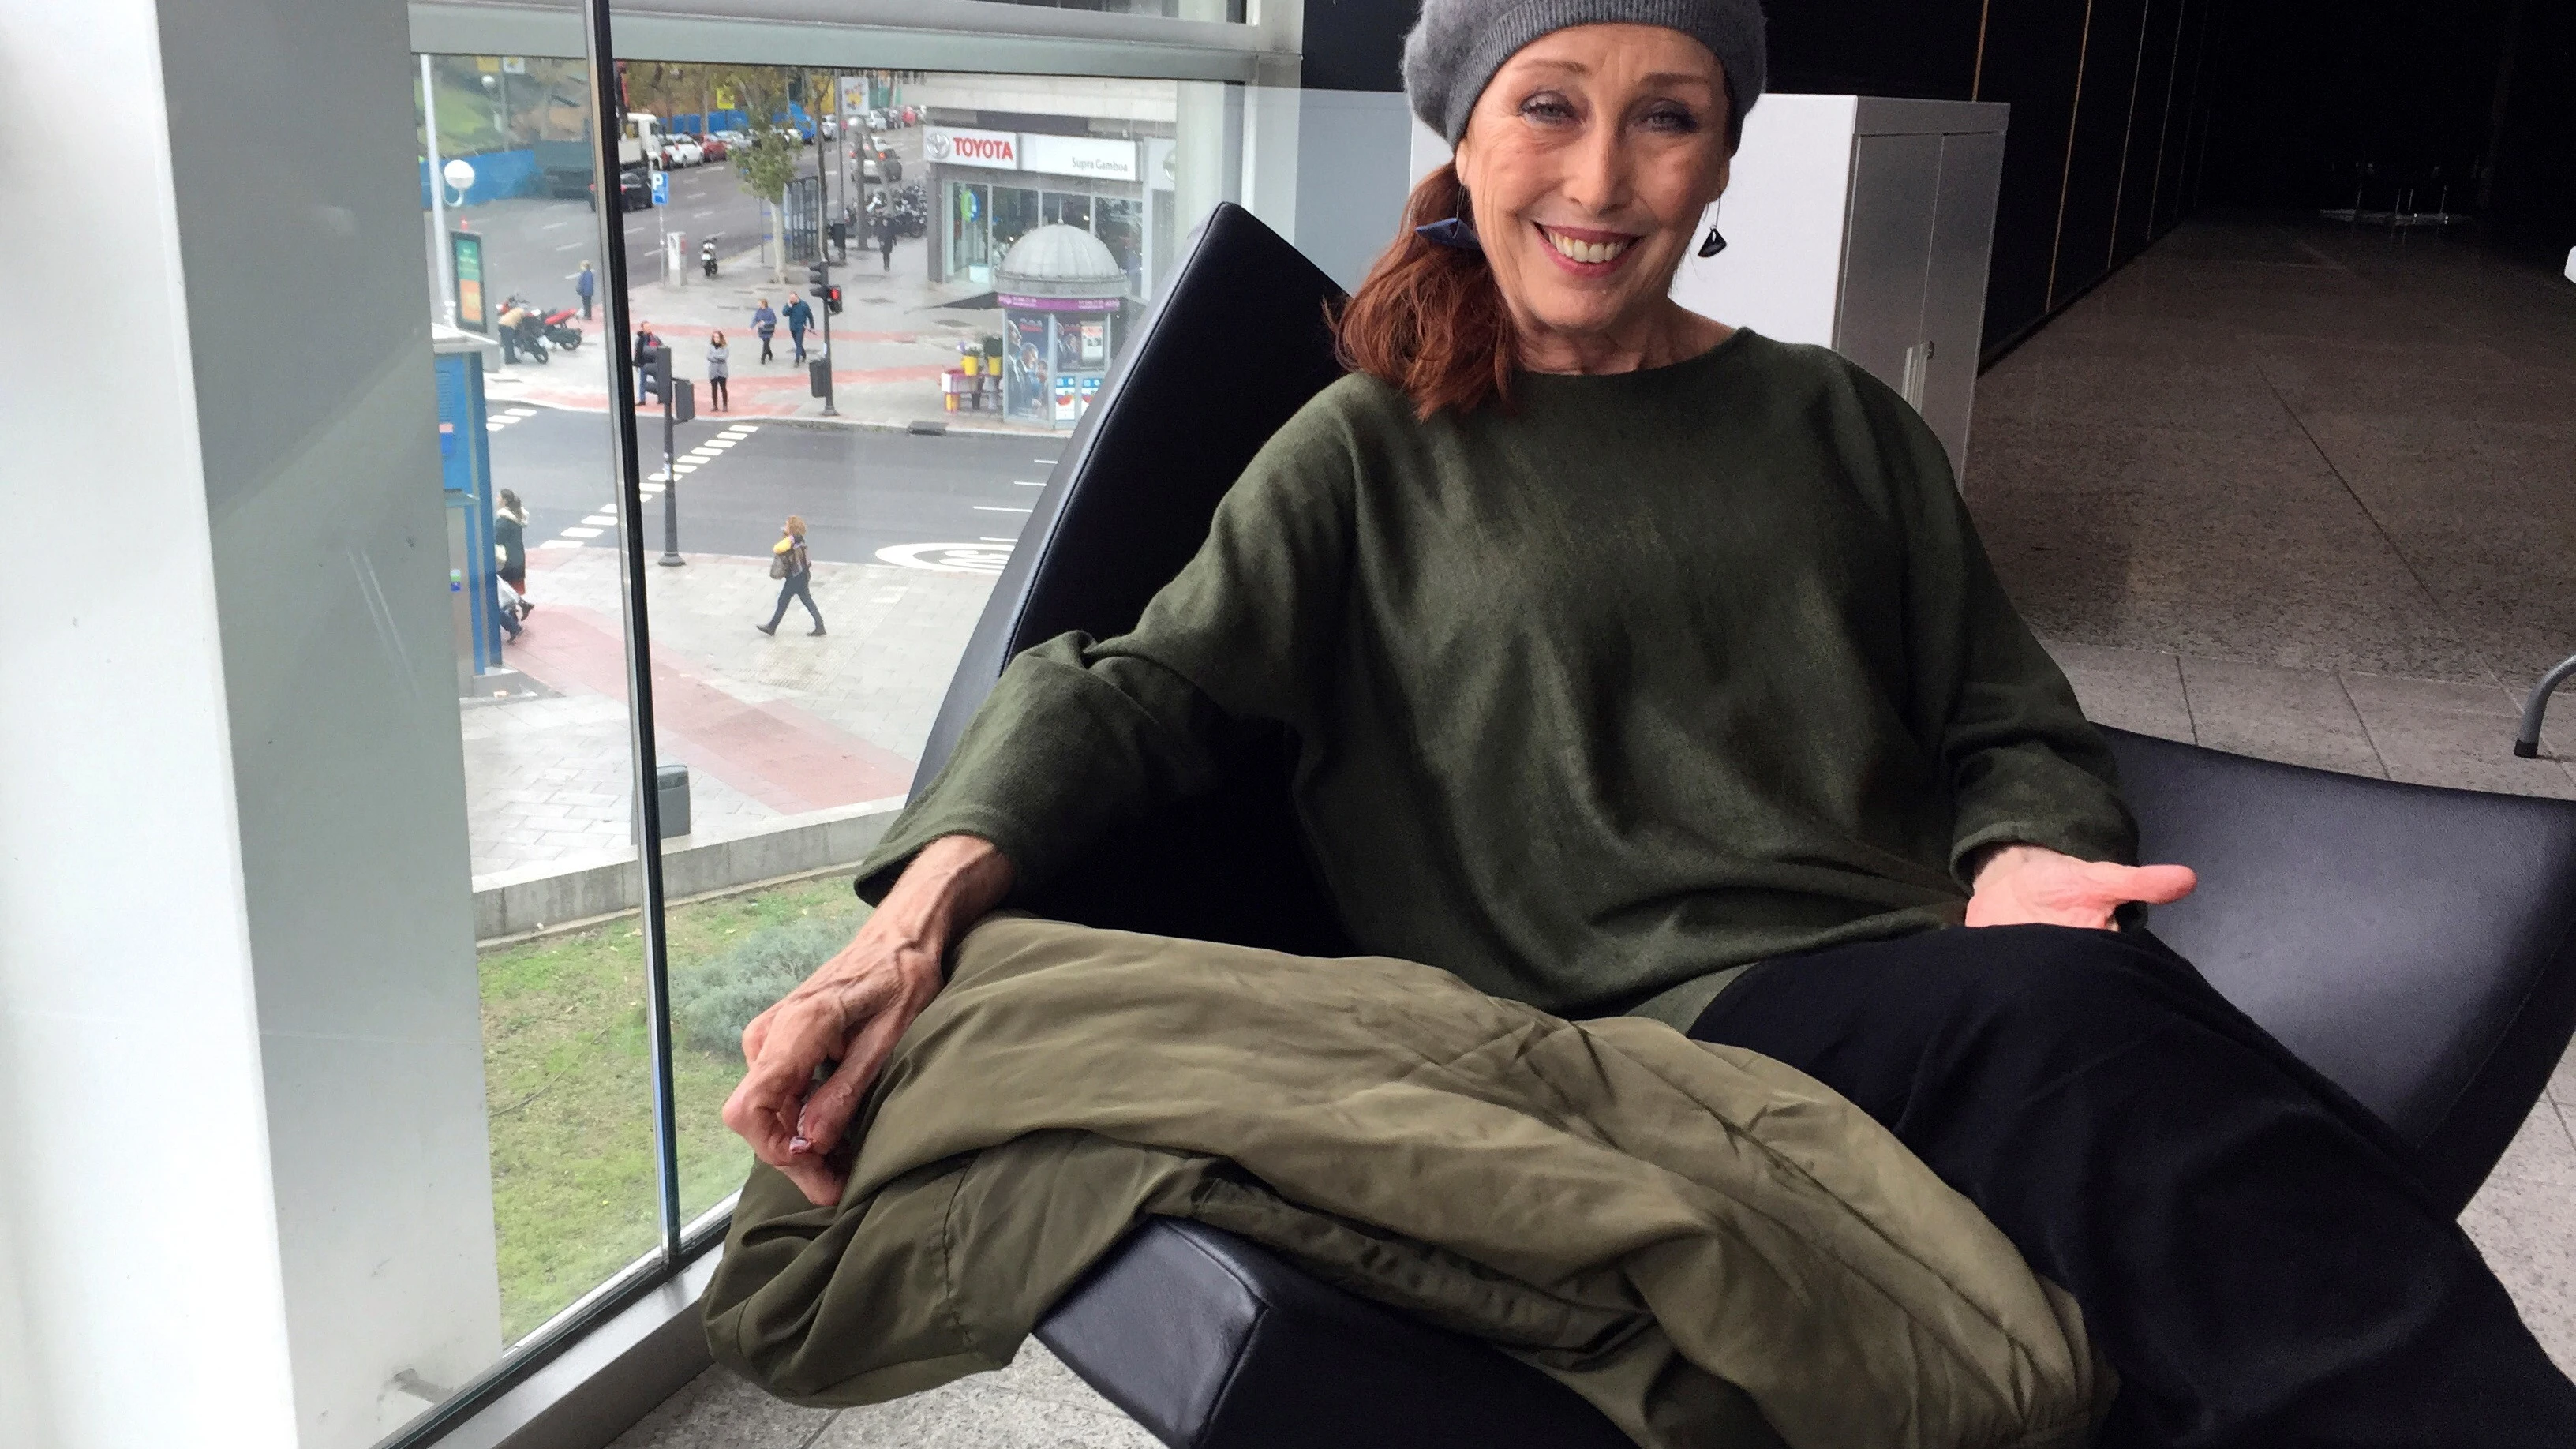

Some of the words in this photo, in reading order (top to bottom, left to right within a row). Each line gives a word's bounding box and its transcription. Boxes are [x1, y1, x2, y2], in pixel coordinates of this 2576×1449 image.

[953, 137, 1014, 160] TOYOTA
[1072, 156, 1095, 170] Supra
[1095, 158, 1129, 172] Gamboa
[653, 173, 664, 191] P
